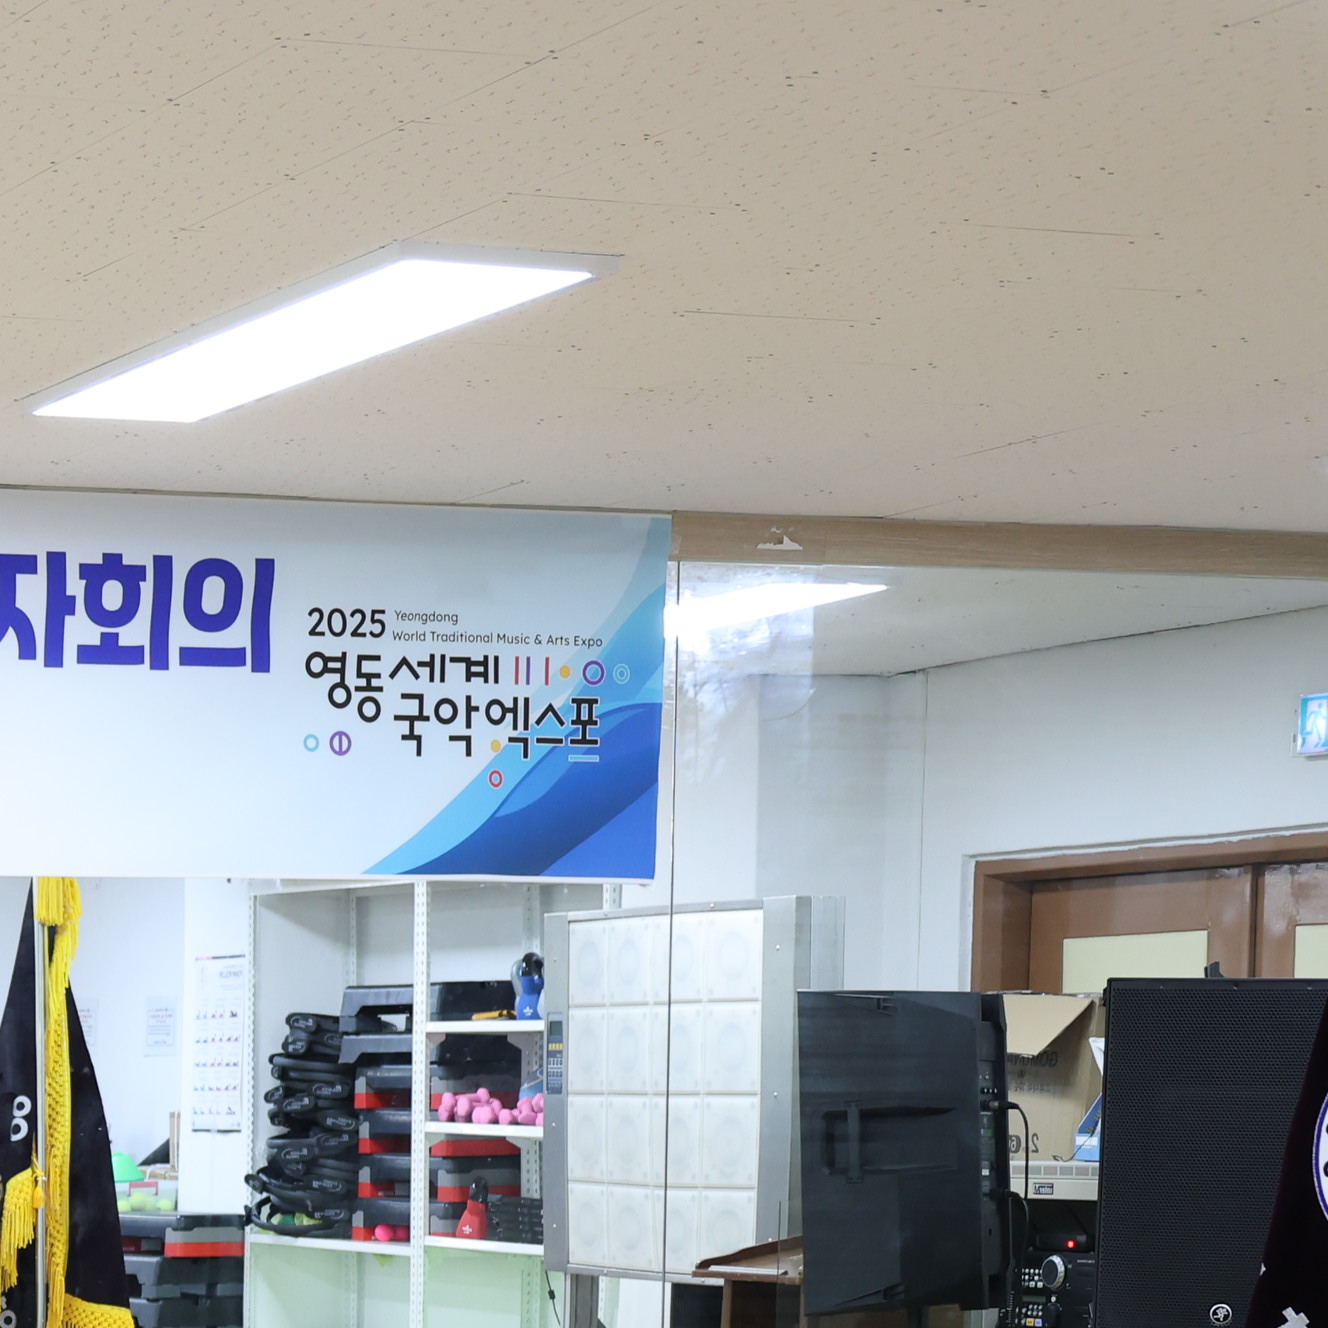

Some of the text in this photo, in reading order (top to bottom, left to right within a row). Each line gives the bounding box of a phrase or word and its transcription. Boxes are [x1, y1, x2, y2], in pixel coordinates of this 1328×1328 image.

[307, 606, 458, 639] 2025 Yeongdong
[392, 630, 603, 650] World Traditional Music & Arts Expo
